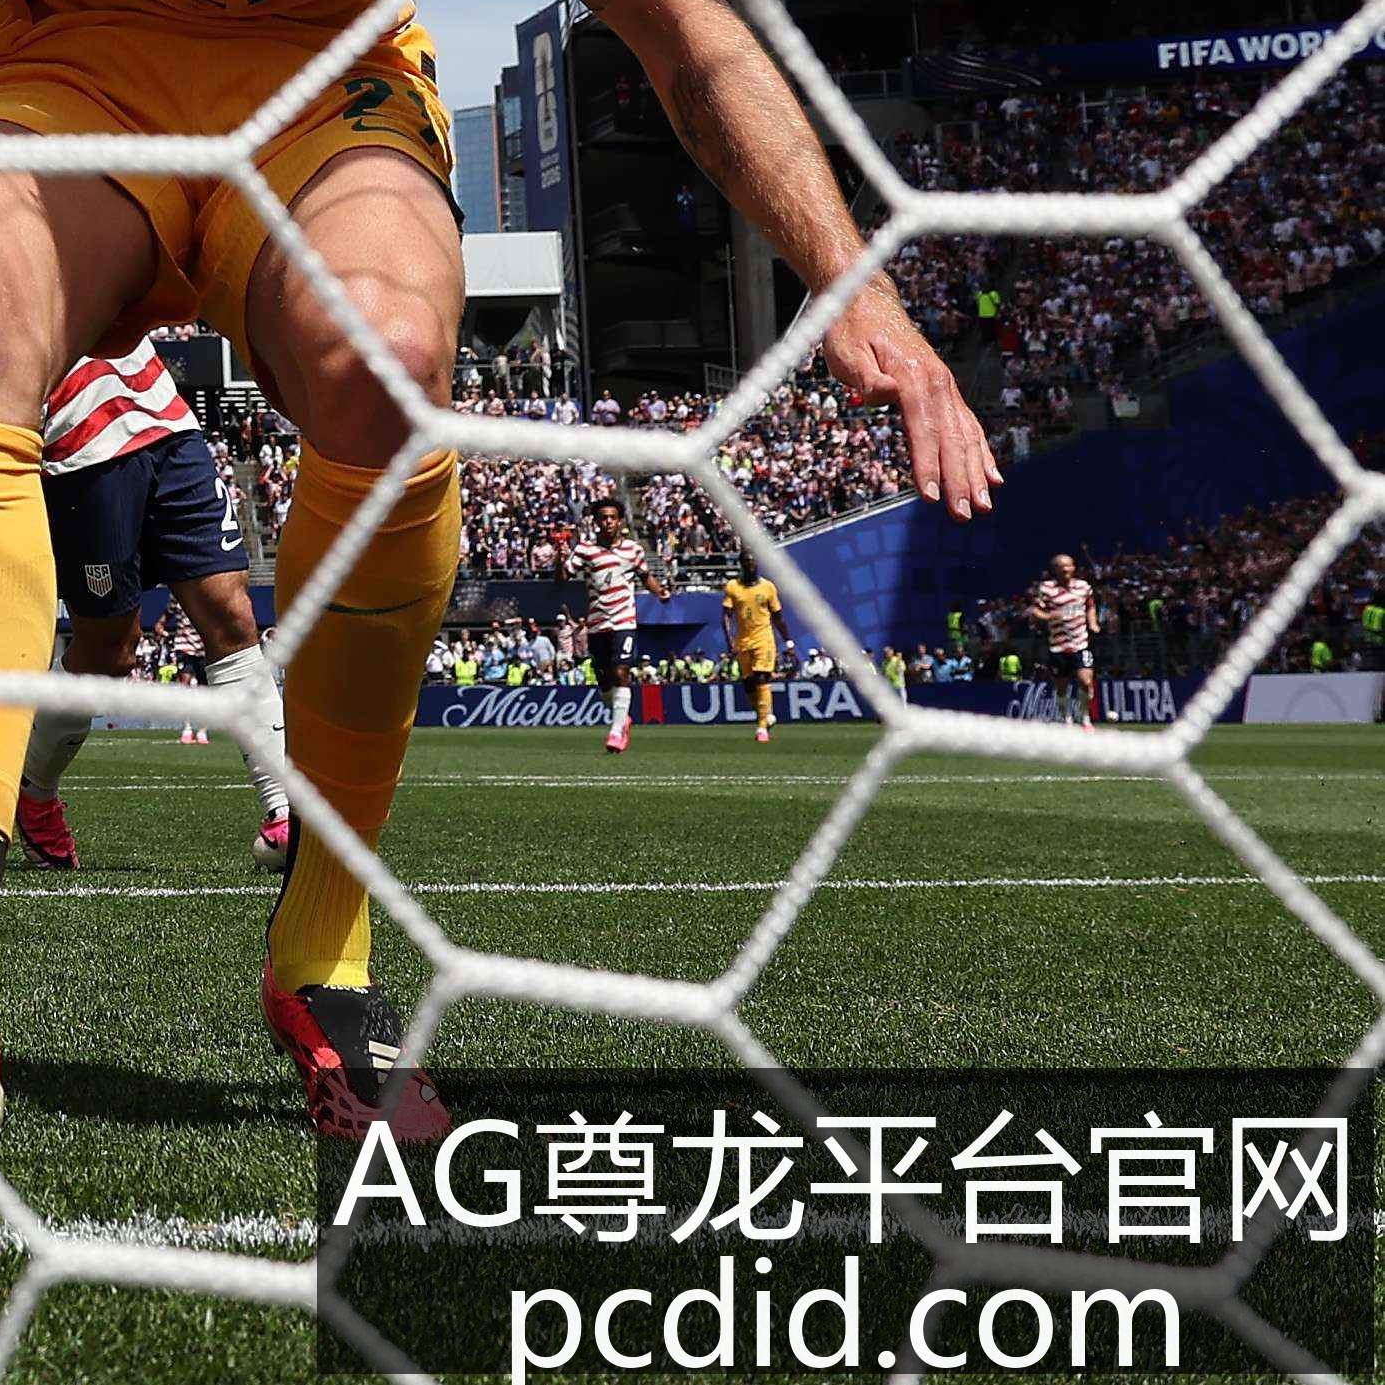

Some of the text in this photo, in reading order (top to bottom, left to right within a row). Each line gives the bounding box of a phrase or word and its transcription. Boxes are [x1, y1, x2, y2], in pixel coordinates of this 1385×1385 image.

[1157, 37, 1235, 70] FIFA
[86, 566, 109, 579] USA
[442, 684, 616, 728] Michelo
[1101, 679, 1177, 722] ULTRA
